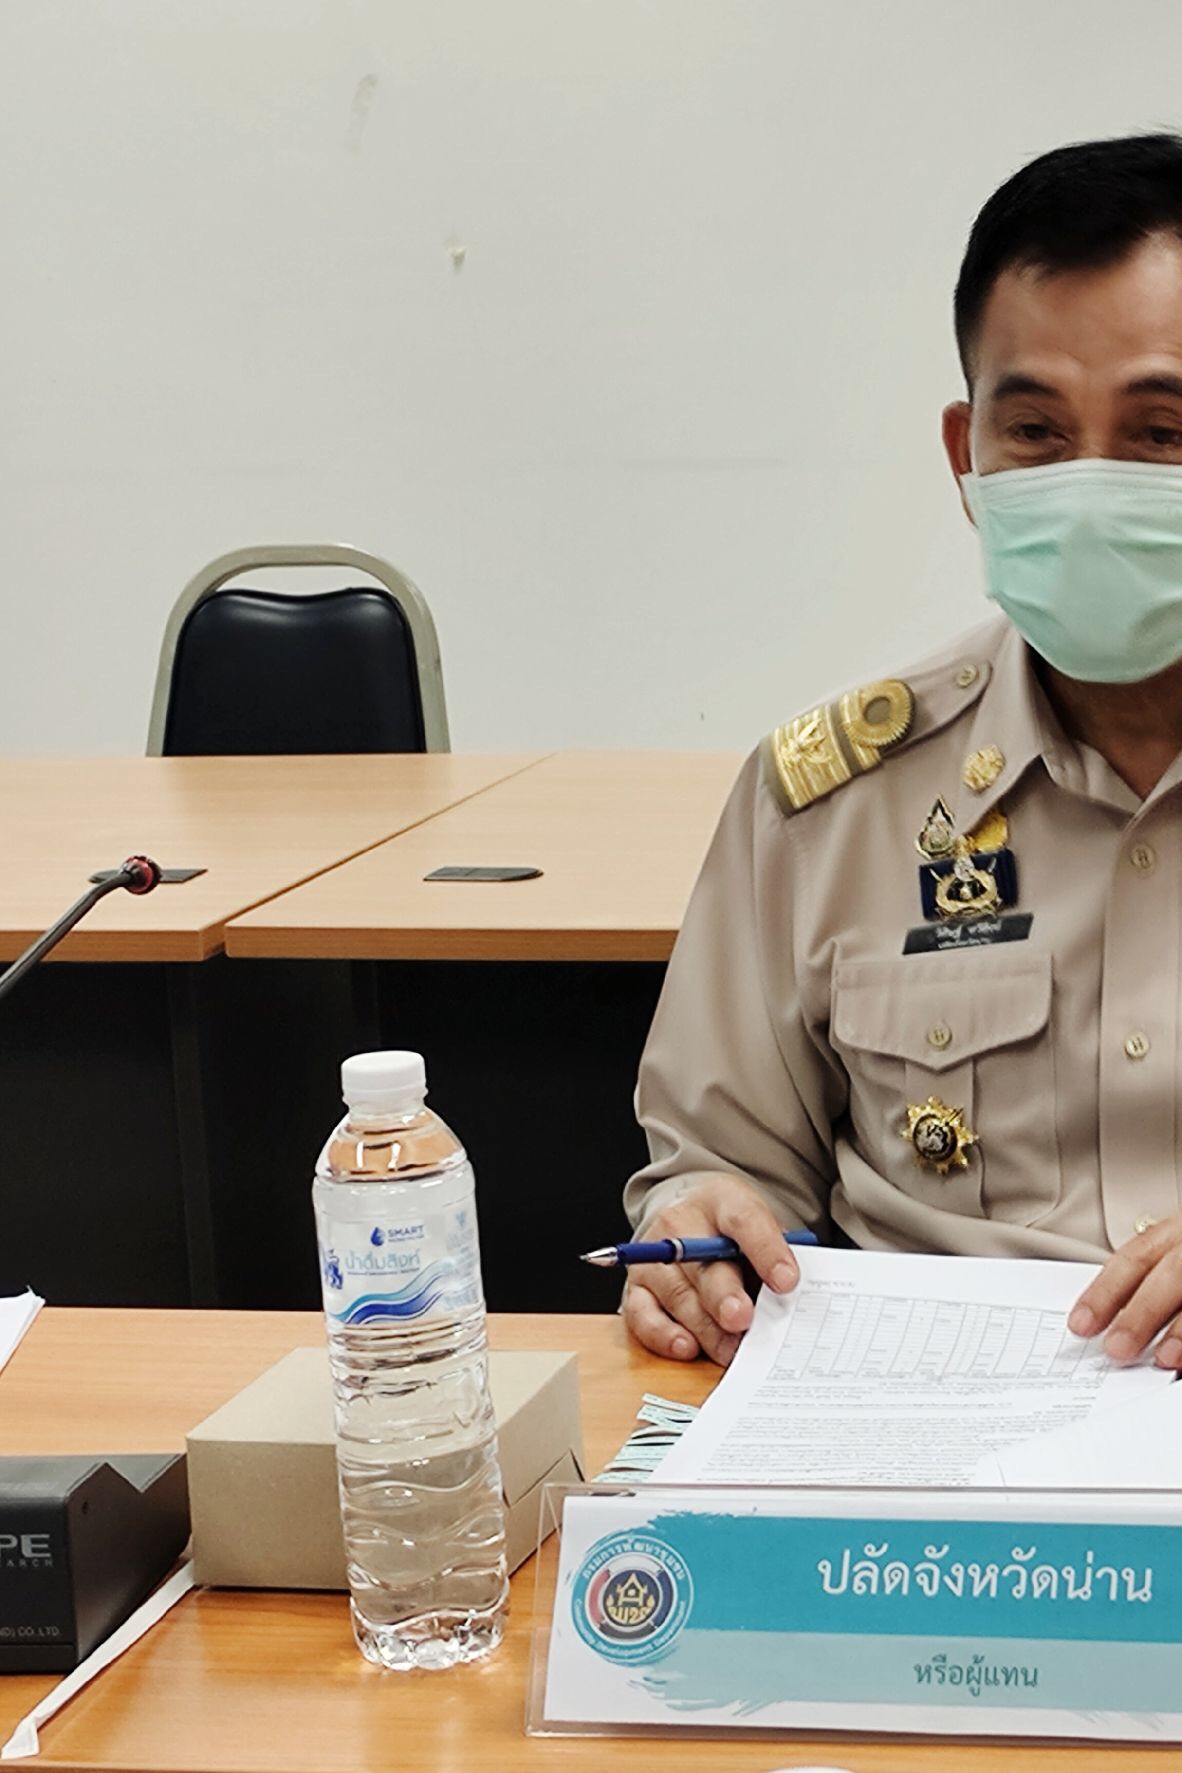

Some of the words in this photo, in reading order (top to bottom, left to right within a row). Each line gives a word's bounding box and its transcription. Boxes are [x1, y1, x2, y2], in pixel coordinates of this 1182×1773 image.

[386, 1224, 425, 1238] SMART
[0, 1558, 53, 1568] ARCH
[816, 1543, 1154, 1602] ปลัดจังหวัดน่าน
[913, 1654, 1039, 1697] หรือผู้แทน
